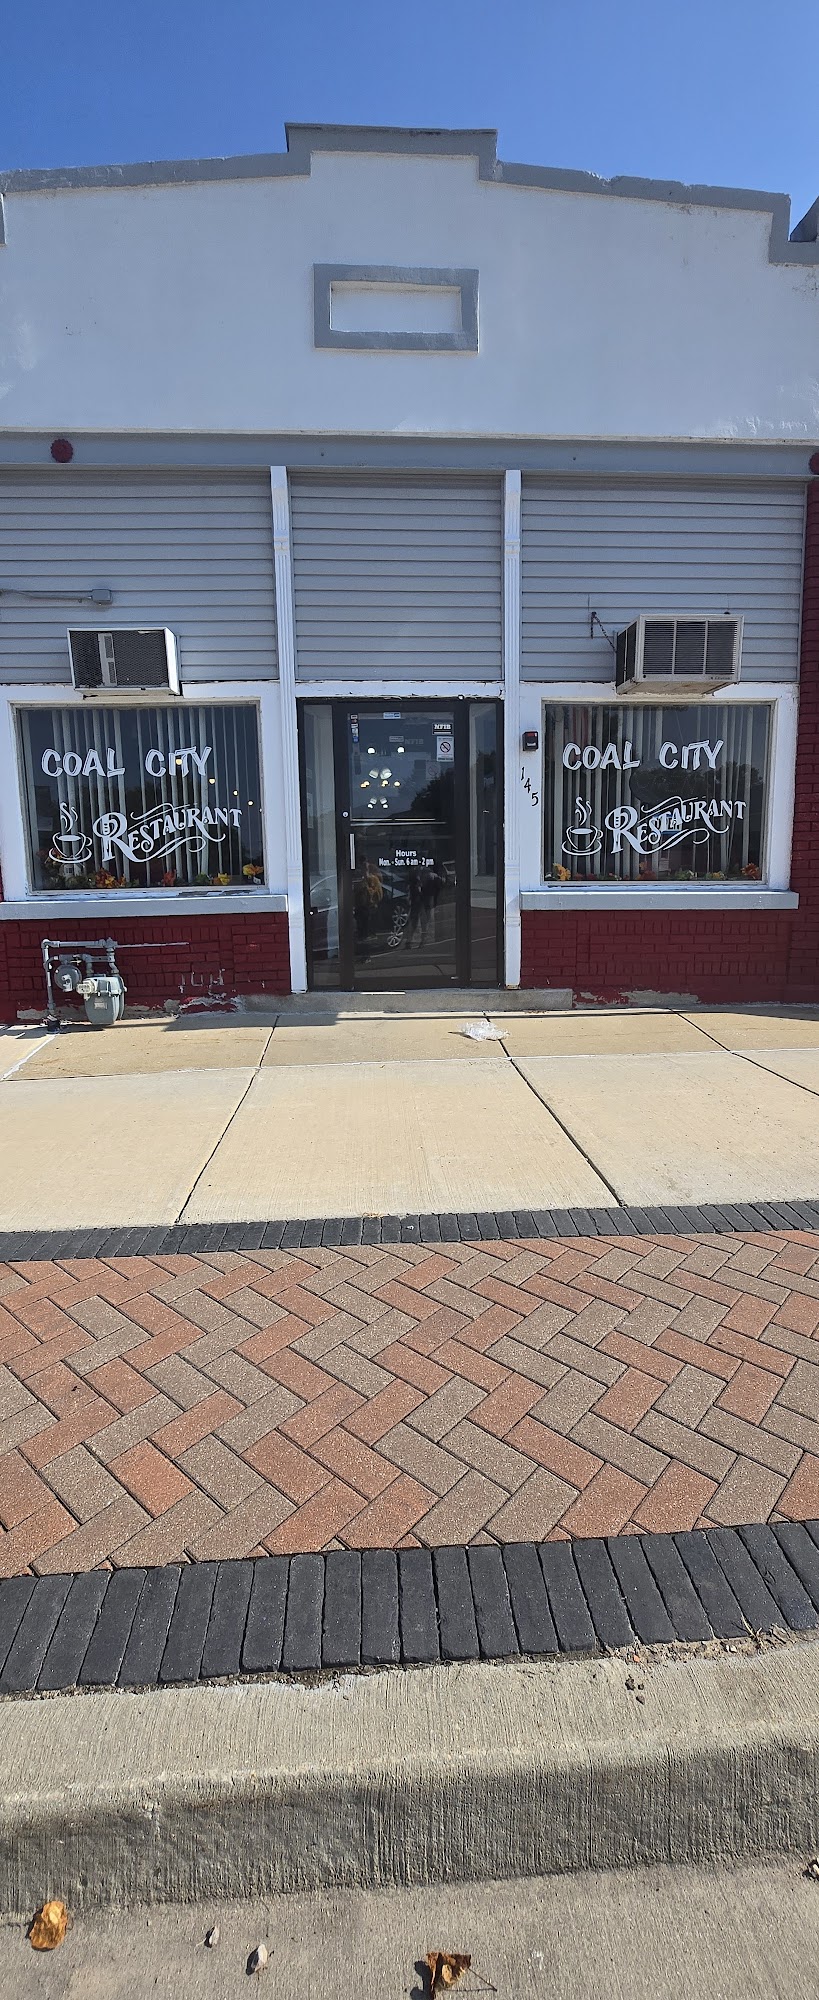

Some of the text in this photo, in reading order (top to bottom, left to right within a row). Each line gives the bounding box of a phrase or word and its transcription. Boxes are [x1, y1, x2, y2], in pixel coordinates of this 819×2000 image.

[41, 746, 213, 778] COAL CITY
[562, 739, 725, 771] COAL CITY
[92, 804, 243, 862] RESTAURANT
[604, 797, 747, 855] RESTAURANT
[378, 857, 391, 866] Mon.
[394, 857, 406, 866] Sun.
[406, 857, 410, 866] 6
[410, 858, 419, 866] am
[421, 857, 426, 866] 2
[425, 858, 435, 868] pm
[395, 849, 417, 857] Hours
